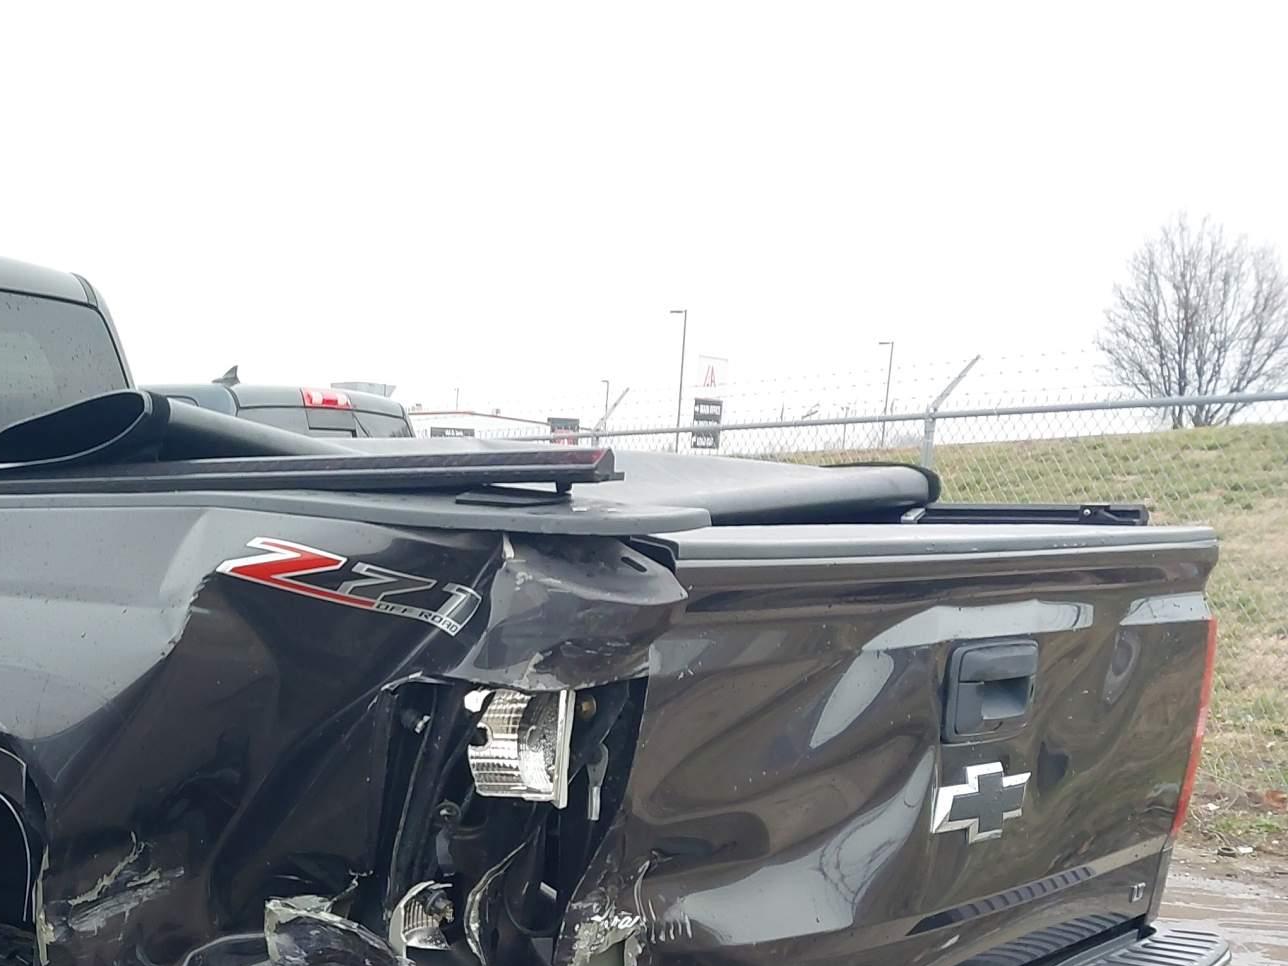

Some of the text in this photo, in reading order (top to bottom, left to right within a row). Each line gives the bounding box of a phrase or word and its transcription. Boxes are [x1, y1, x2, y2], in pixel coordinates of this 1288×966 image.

[215, 536, 483, 627] Z71
[375, 601, 460, 635] OFF ROAD
